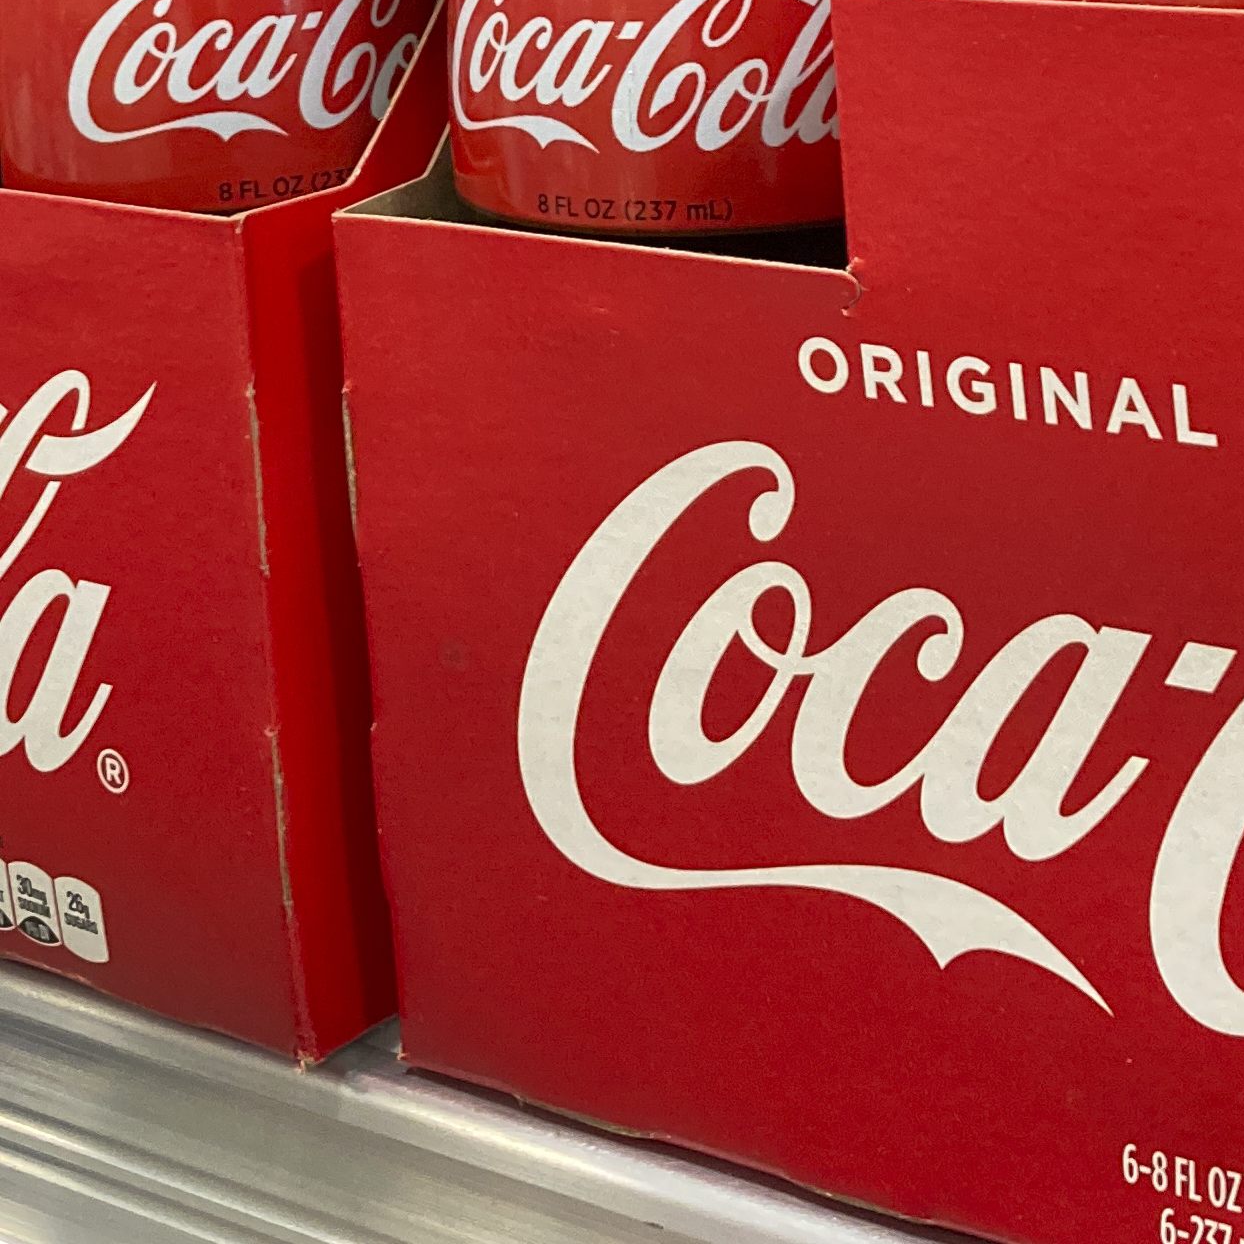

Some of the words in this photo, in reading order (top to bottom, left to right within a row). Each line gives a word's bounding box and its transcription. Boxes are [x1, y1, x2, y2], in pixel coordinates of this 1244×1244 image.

[218, 181, 233, 201] 8
[239, 179, 265, 199] FL
[272, 174, 304, 196] OZ
[538, 193, 550, 215] 8
[555, 195, 579, 218] FL
[584, 198, 616, 220] OZ
[623, 199, 676, 223] (237
[686, 197, 733, 223] mL)
[799, 335, 1218, 448] ORIGINAL
[1122, 1143, 1168, 1192] 6-8
[1175, 1156, 1202, 1202] FL
[1208, 1166, 1242, 1214] OZ
[1160, 1207, 1232, 1244] 6-237
